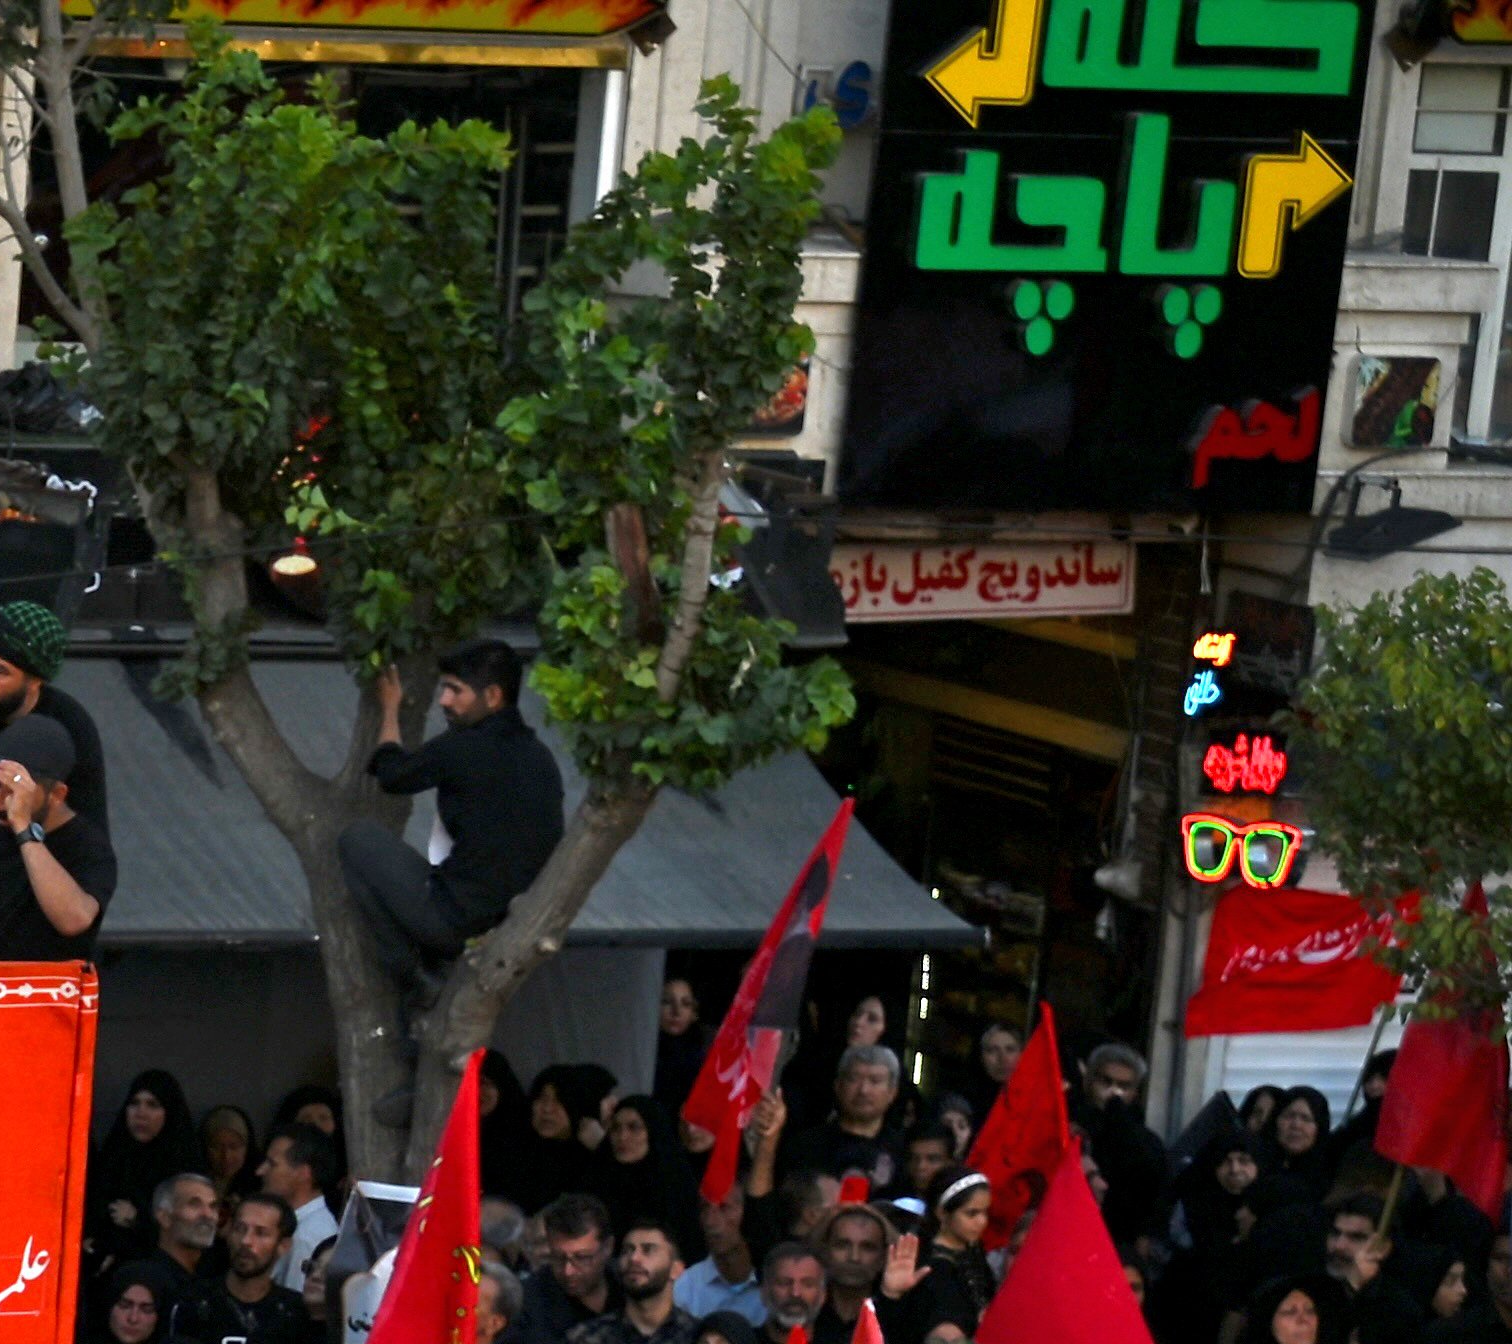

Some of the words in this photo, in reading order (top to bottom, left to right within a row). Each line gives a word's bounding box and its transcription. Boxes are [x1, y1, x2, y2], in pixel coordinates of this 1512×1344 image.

[914, 112, 1238, 360] پاچه
[1189, 385, 1320, 490] لحم
[891, 546, 976, 605] کفیل
[978, 542, 1123, 602] ساندویچ
